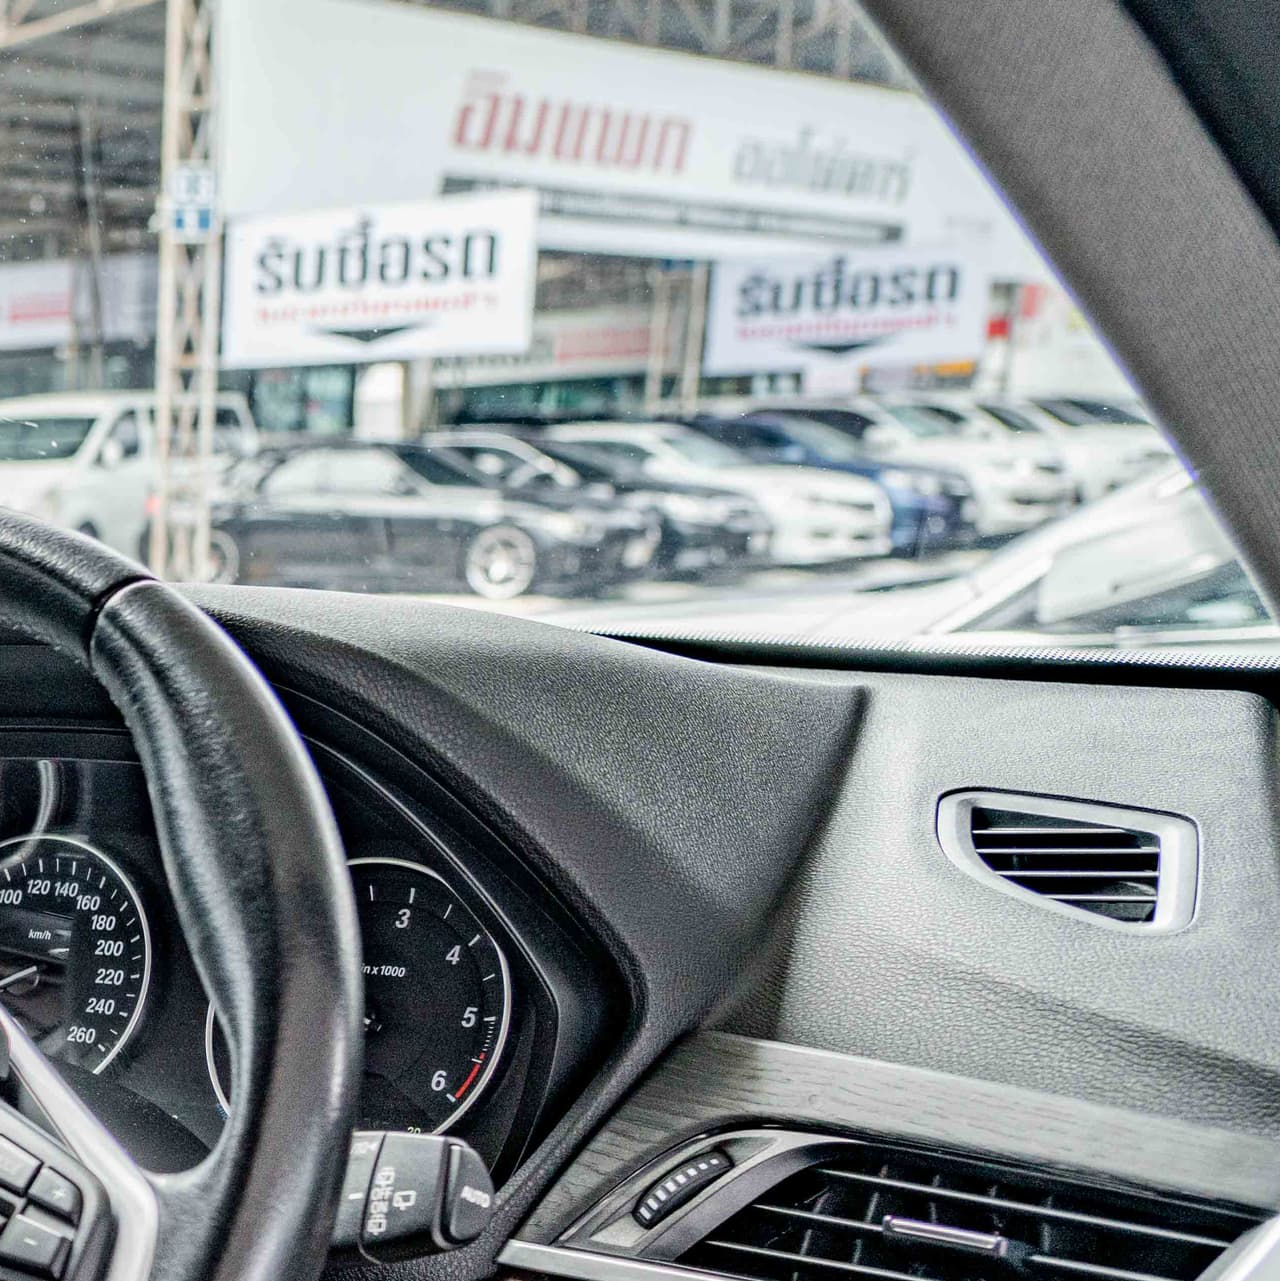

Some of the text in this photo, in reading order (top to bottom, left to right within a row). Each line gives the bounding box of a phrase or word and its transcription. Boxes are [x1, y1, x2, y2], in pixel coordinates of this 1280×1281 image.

[27, 879, 51, 895] 120
[54, 883, 79, 898] 140
[0, 889, 23, 905] 100
[76, 895, 101, 911] 160
[91, 914, 116, 931] 180
[395, 908, 411, 929] 3
[28, 928, 52, 941] km/h
[94, 940, 124, 957] 200
[446, 944, 462, 965] 4
[95, 969, 124, 986] 220
[86, 998, 115, 1015] 240
[461, 1007, 478, 1028] 5
[67, 1026, 96, 1044] 260
[430, 1070, 448, 1091] 6
